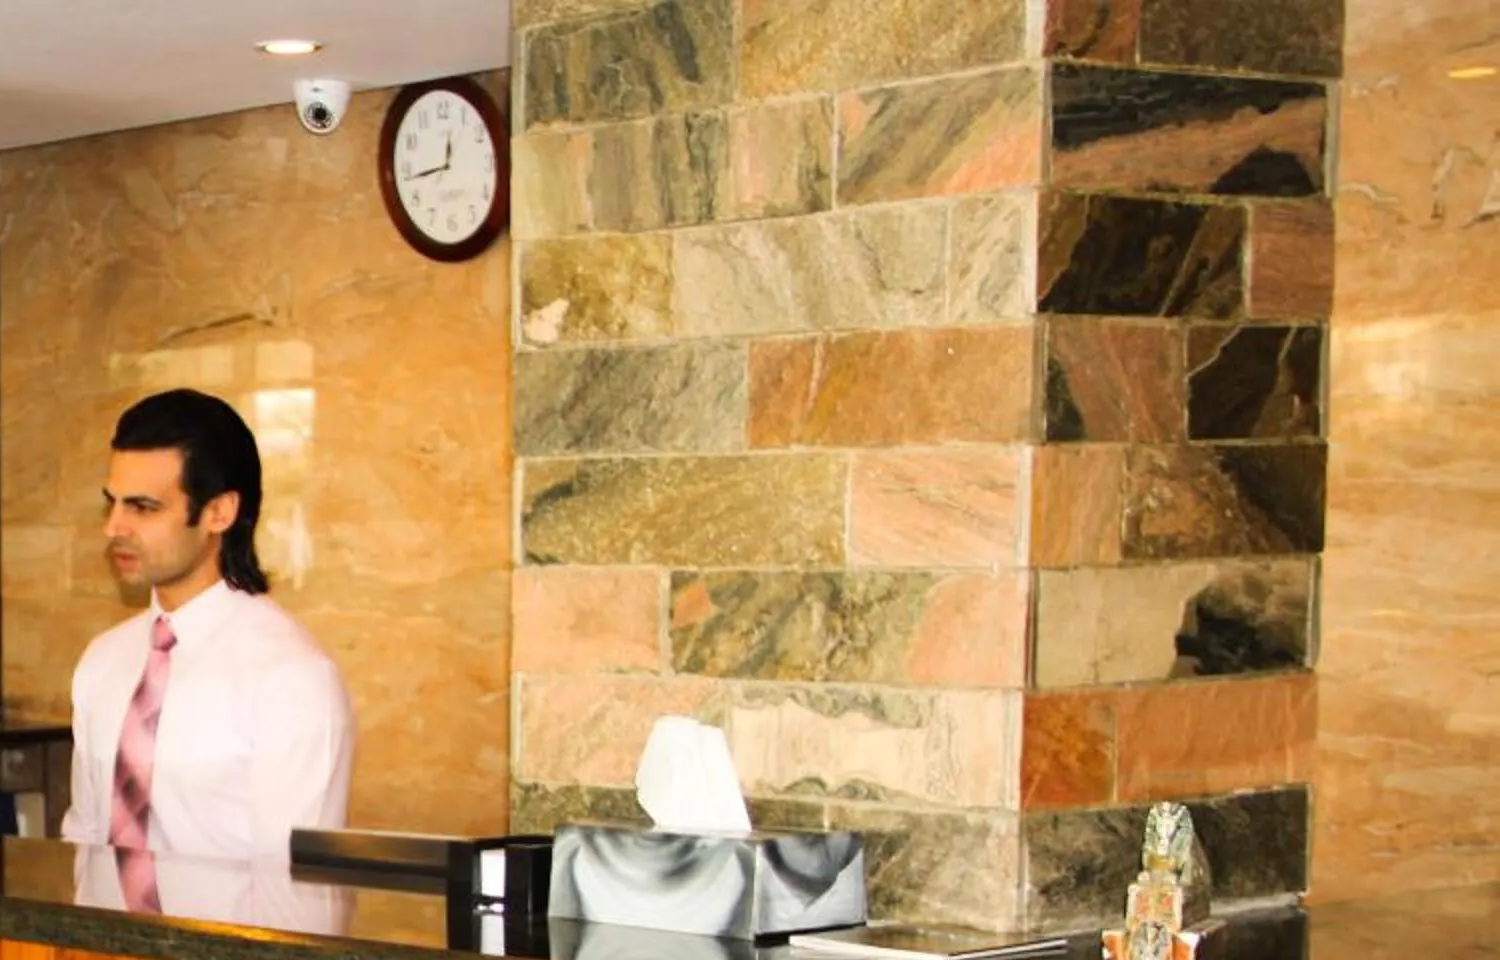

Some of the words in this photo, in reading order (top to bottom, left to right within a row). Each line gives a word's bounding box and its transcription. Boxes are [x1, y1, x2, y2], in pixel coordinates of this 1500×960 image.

[417, 110, 429, 129] 11
[404, 132, 418, 152] 10
[426, 206, 437, 228] 7
[446, 212, 459, 233] 6
